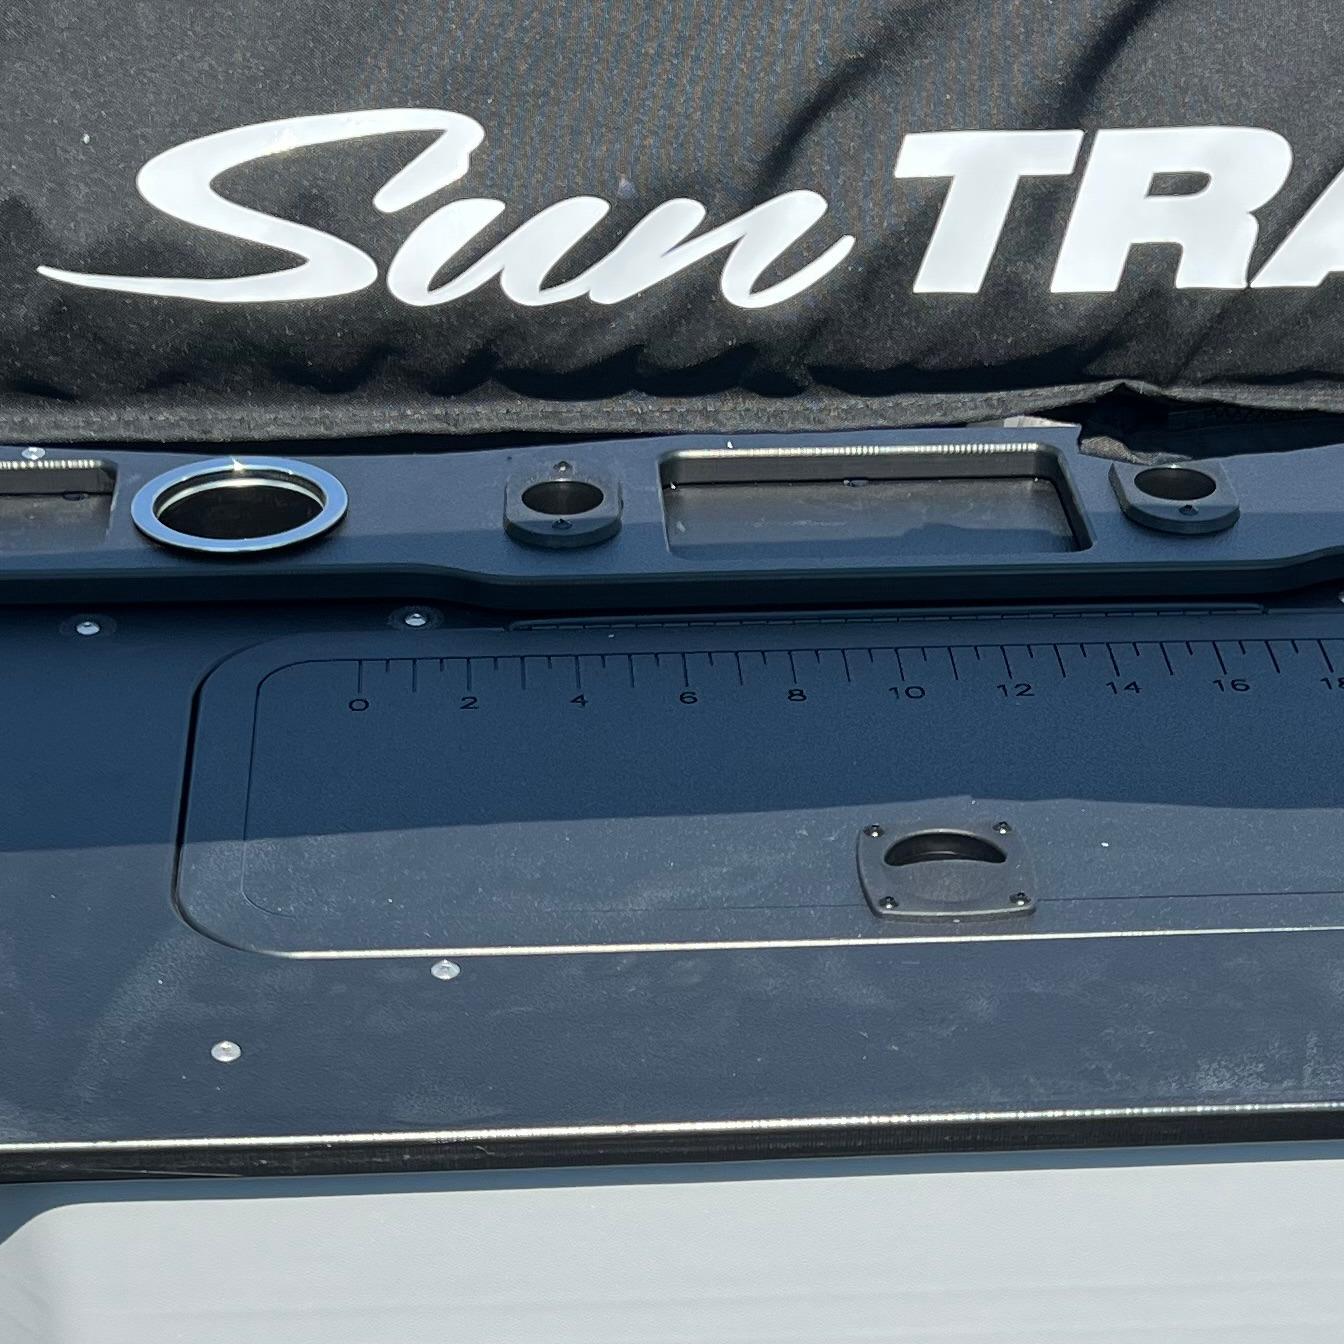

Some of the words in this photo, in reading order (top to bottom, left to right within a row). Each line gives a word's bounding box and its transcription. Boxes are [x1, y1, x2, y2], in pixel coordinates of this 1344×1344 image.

[36, 106, 855, 310] Sun
[348, 698, 370, 712] 0
[459, 695, 479, 710] 2
[570, 693, 588, 708] 4
[679, 691, 698, 705] 6
[787, 688, 808, 702] 8
[889, 685, 926, 700] 10
[997, 682, 1035, 697] 12
[1106, 680, 1142, 694] 14
[1213, 678, 1251, 692] 16
